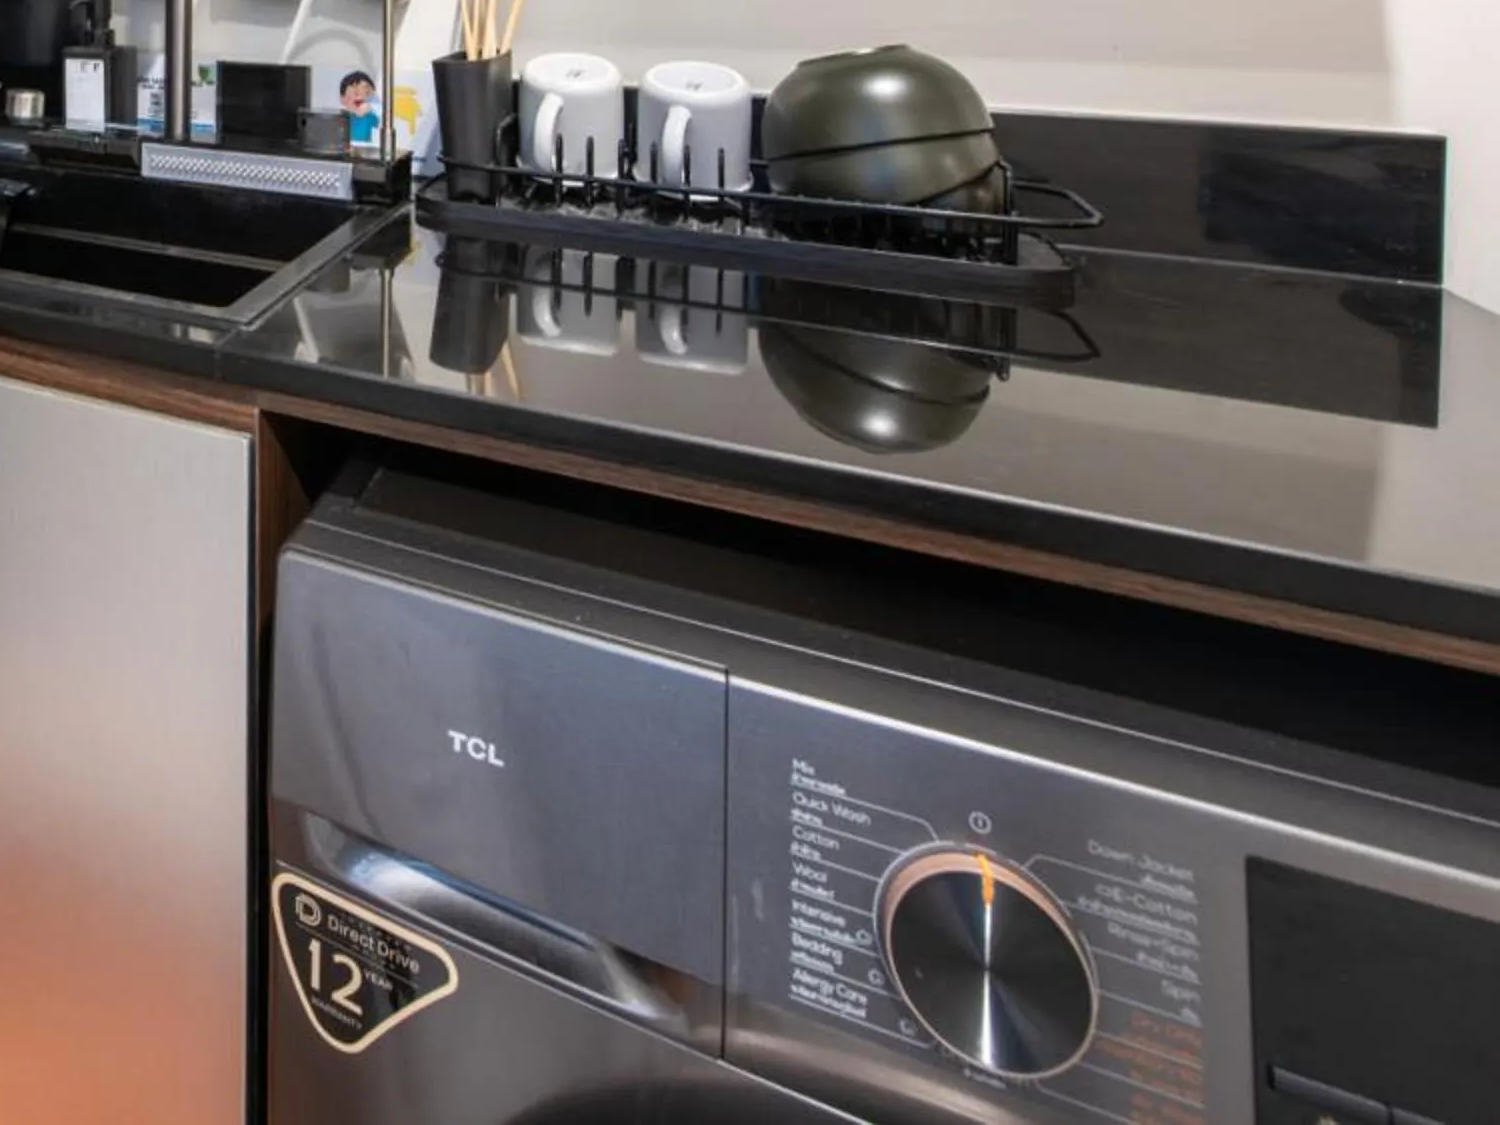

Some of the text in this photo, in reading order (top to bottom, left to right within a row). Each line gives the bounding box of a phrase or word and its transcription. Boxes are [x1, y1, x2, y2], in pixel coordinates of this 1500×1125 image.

[448, 730, 504, 766] TCL
[792, 791, 829, 812] Quick
[831, 799, 872, 826] Wash
[792, 825, 840, 850] Cotton
[792, 861, 828, 883] Wool
[1088, 838, 1195, 882] Down Jacket
[326, 914, 374, 951] Direct
[376, 940, 420, 974] Drive
[791, 931, 843, 966] Bedding
[308, 938, 363, 1016] 12
[835, 982, 868, 1007] Care
